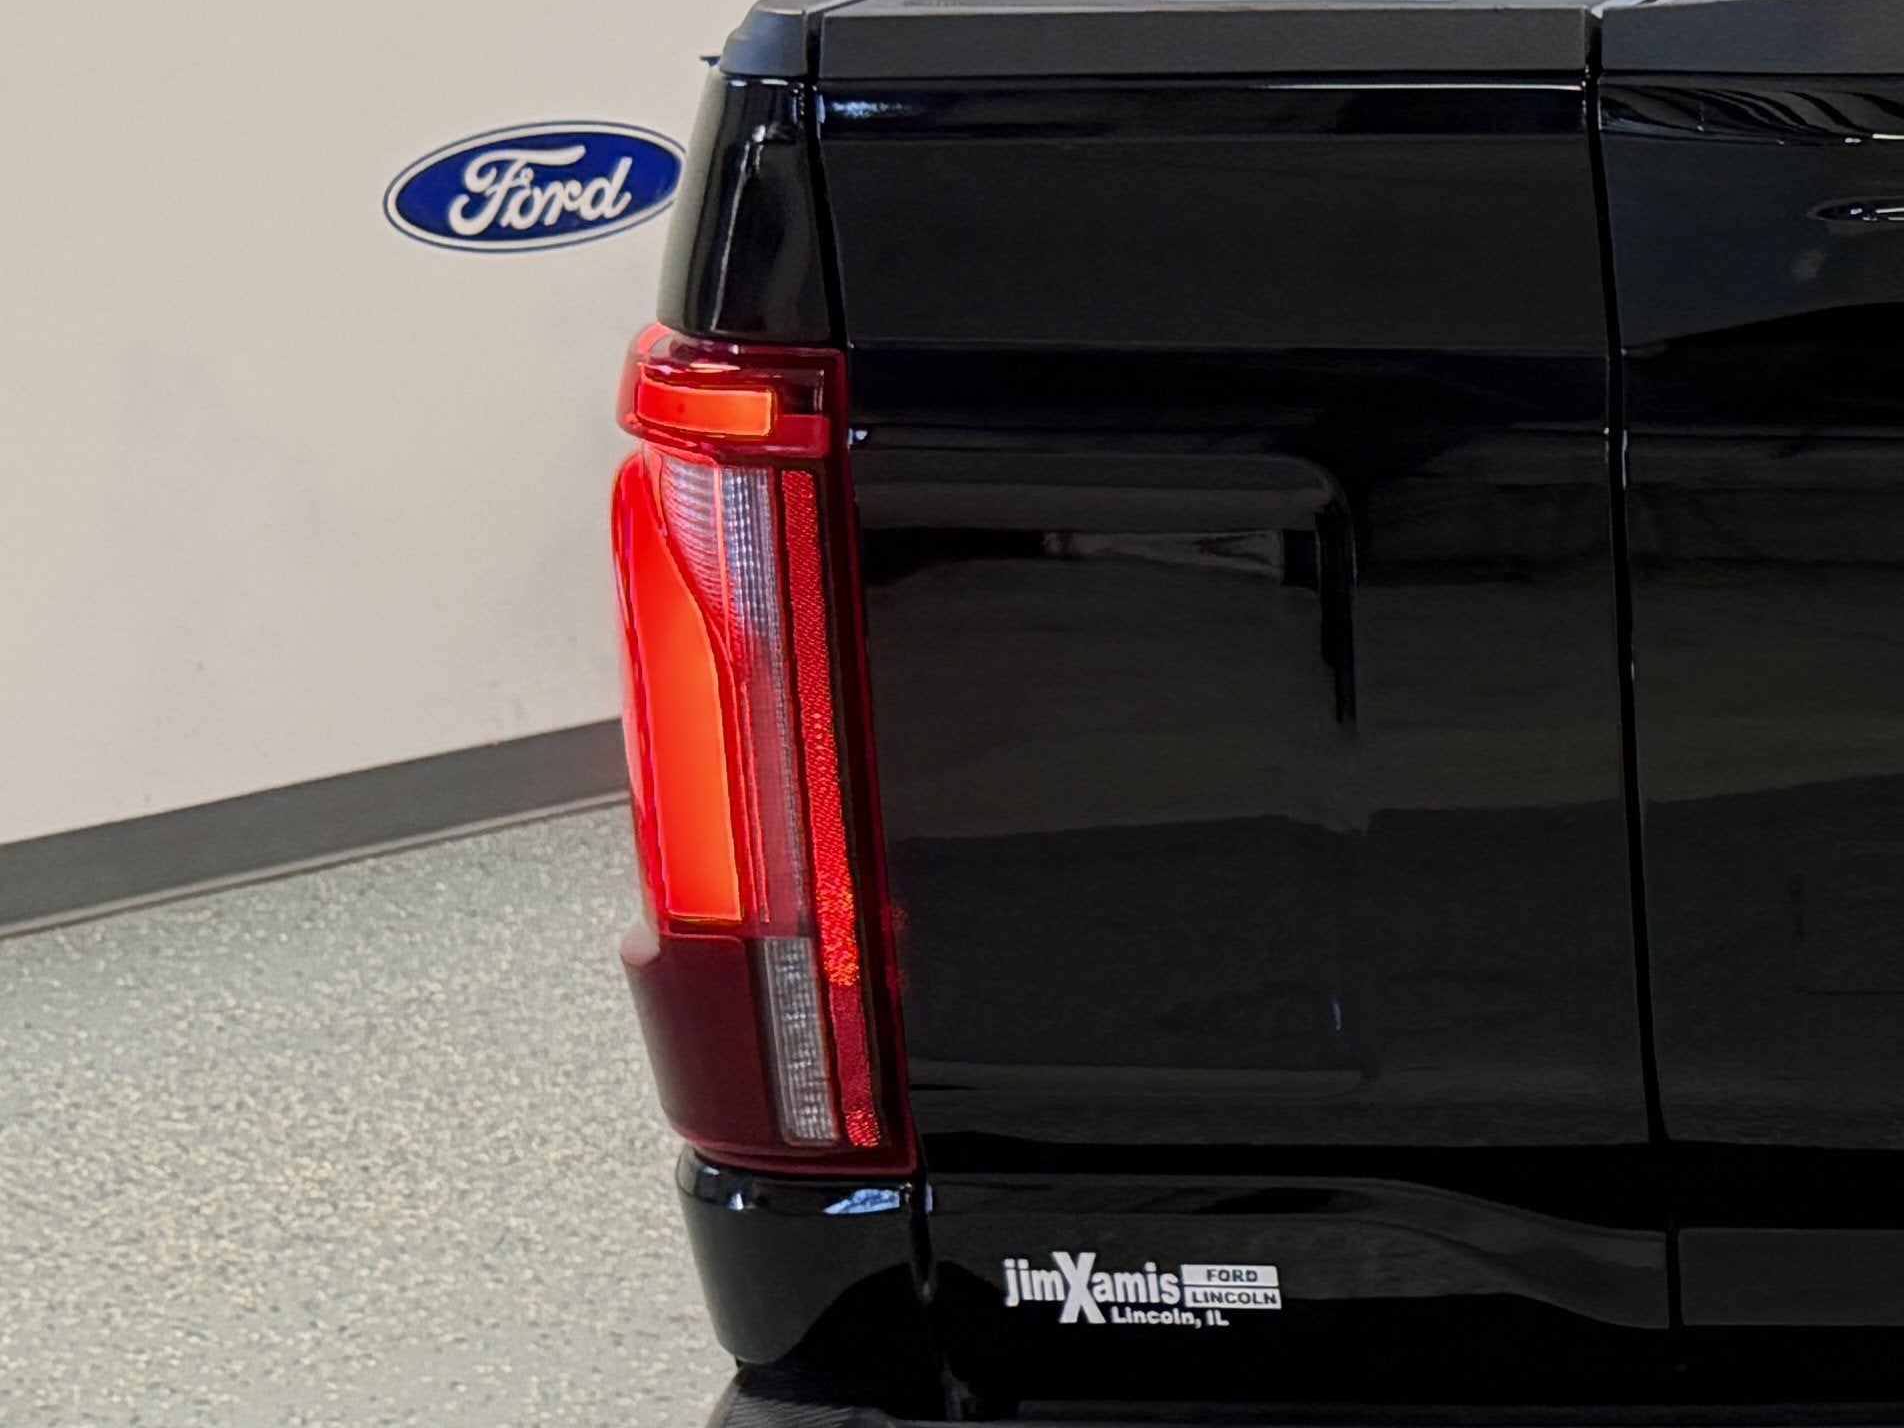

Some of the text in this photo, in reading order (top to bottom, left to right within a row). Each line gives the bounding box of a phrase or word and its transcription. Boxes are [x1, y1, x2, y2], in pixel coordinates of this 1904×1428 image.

[448, 143, 633, 236] Ford
[1206, 1268, 1258, 1284] FORD
[1191, 1290, 1277, 1306] LINCOLN
[1111, 1306, 1230, 1329] Lincoln, IL
